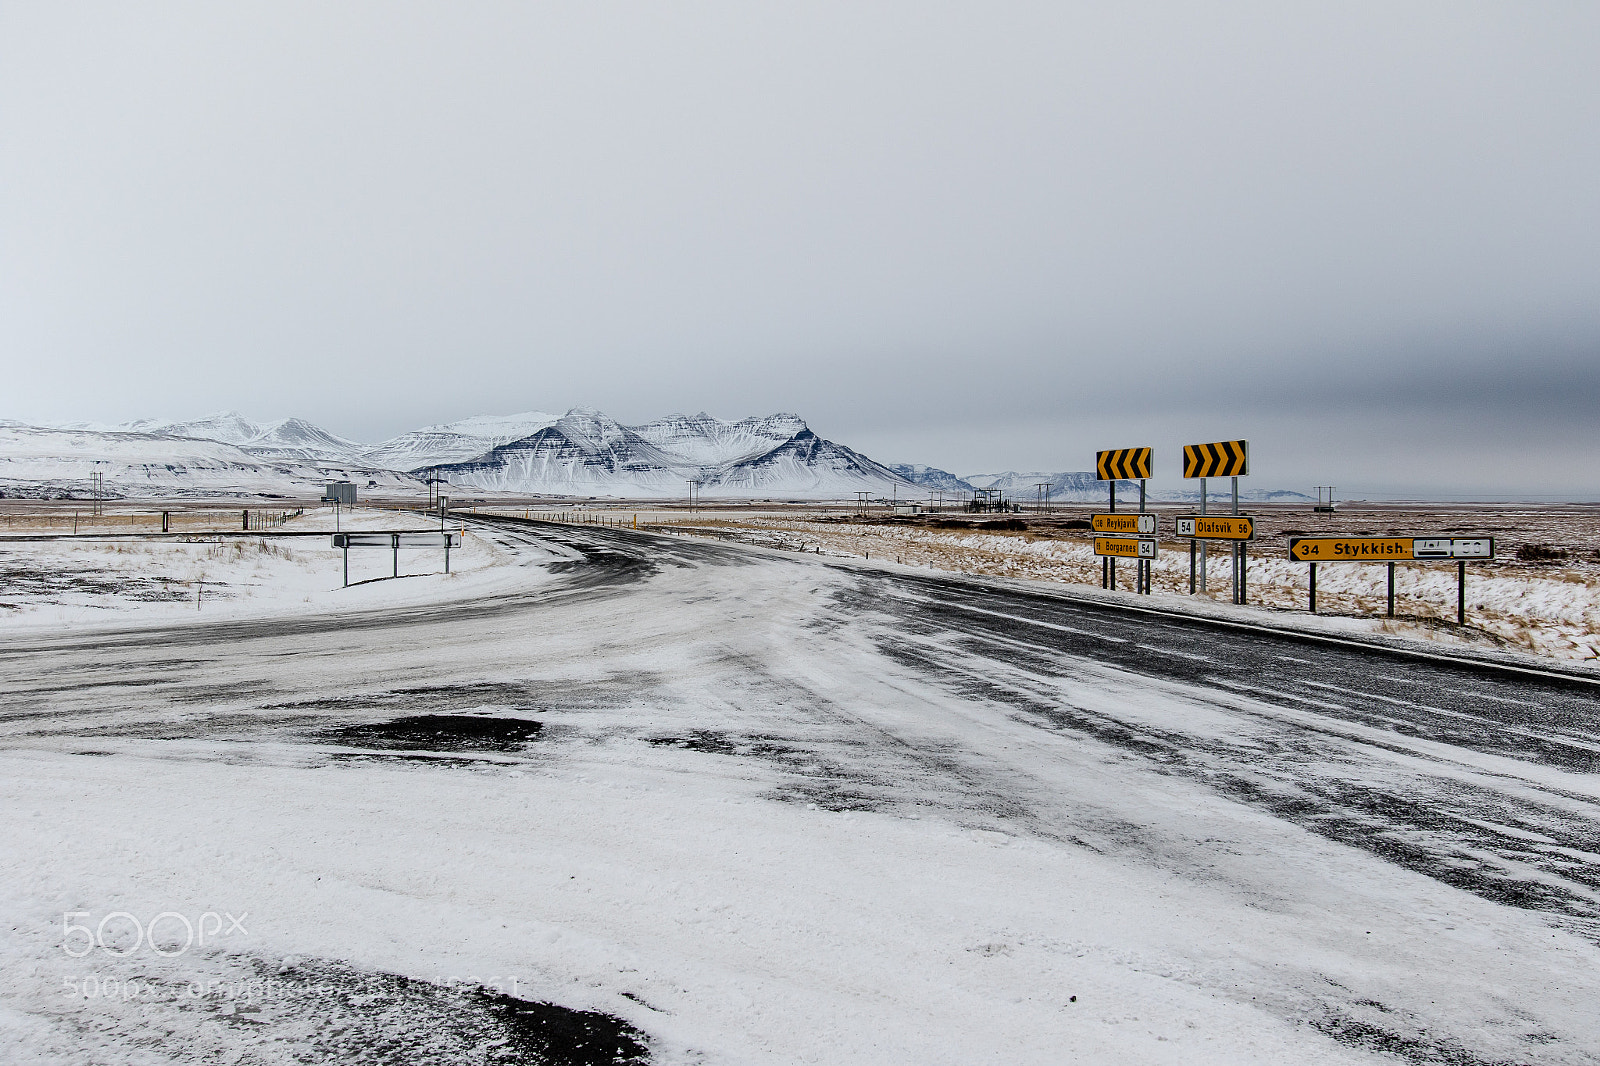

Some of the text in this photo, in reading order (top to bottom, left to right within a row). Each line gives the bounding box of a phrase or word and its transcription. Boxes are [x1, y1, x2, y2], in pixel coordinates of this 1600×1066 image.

[1181, 521, 1191, 533] 54
[1238, 523, 1248, 534] 56
[1105, 541, 1136, 554] Borgarnes
[1141, 543, 1150, 554] 54
[1301, 544, 1320, 555] 34
